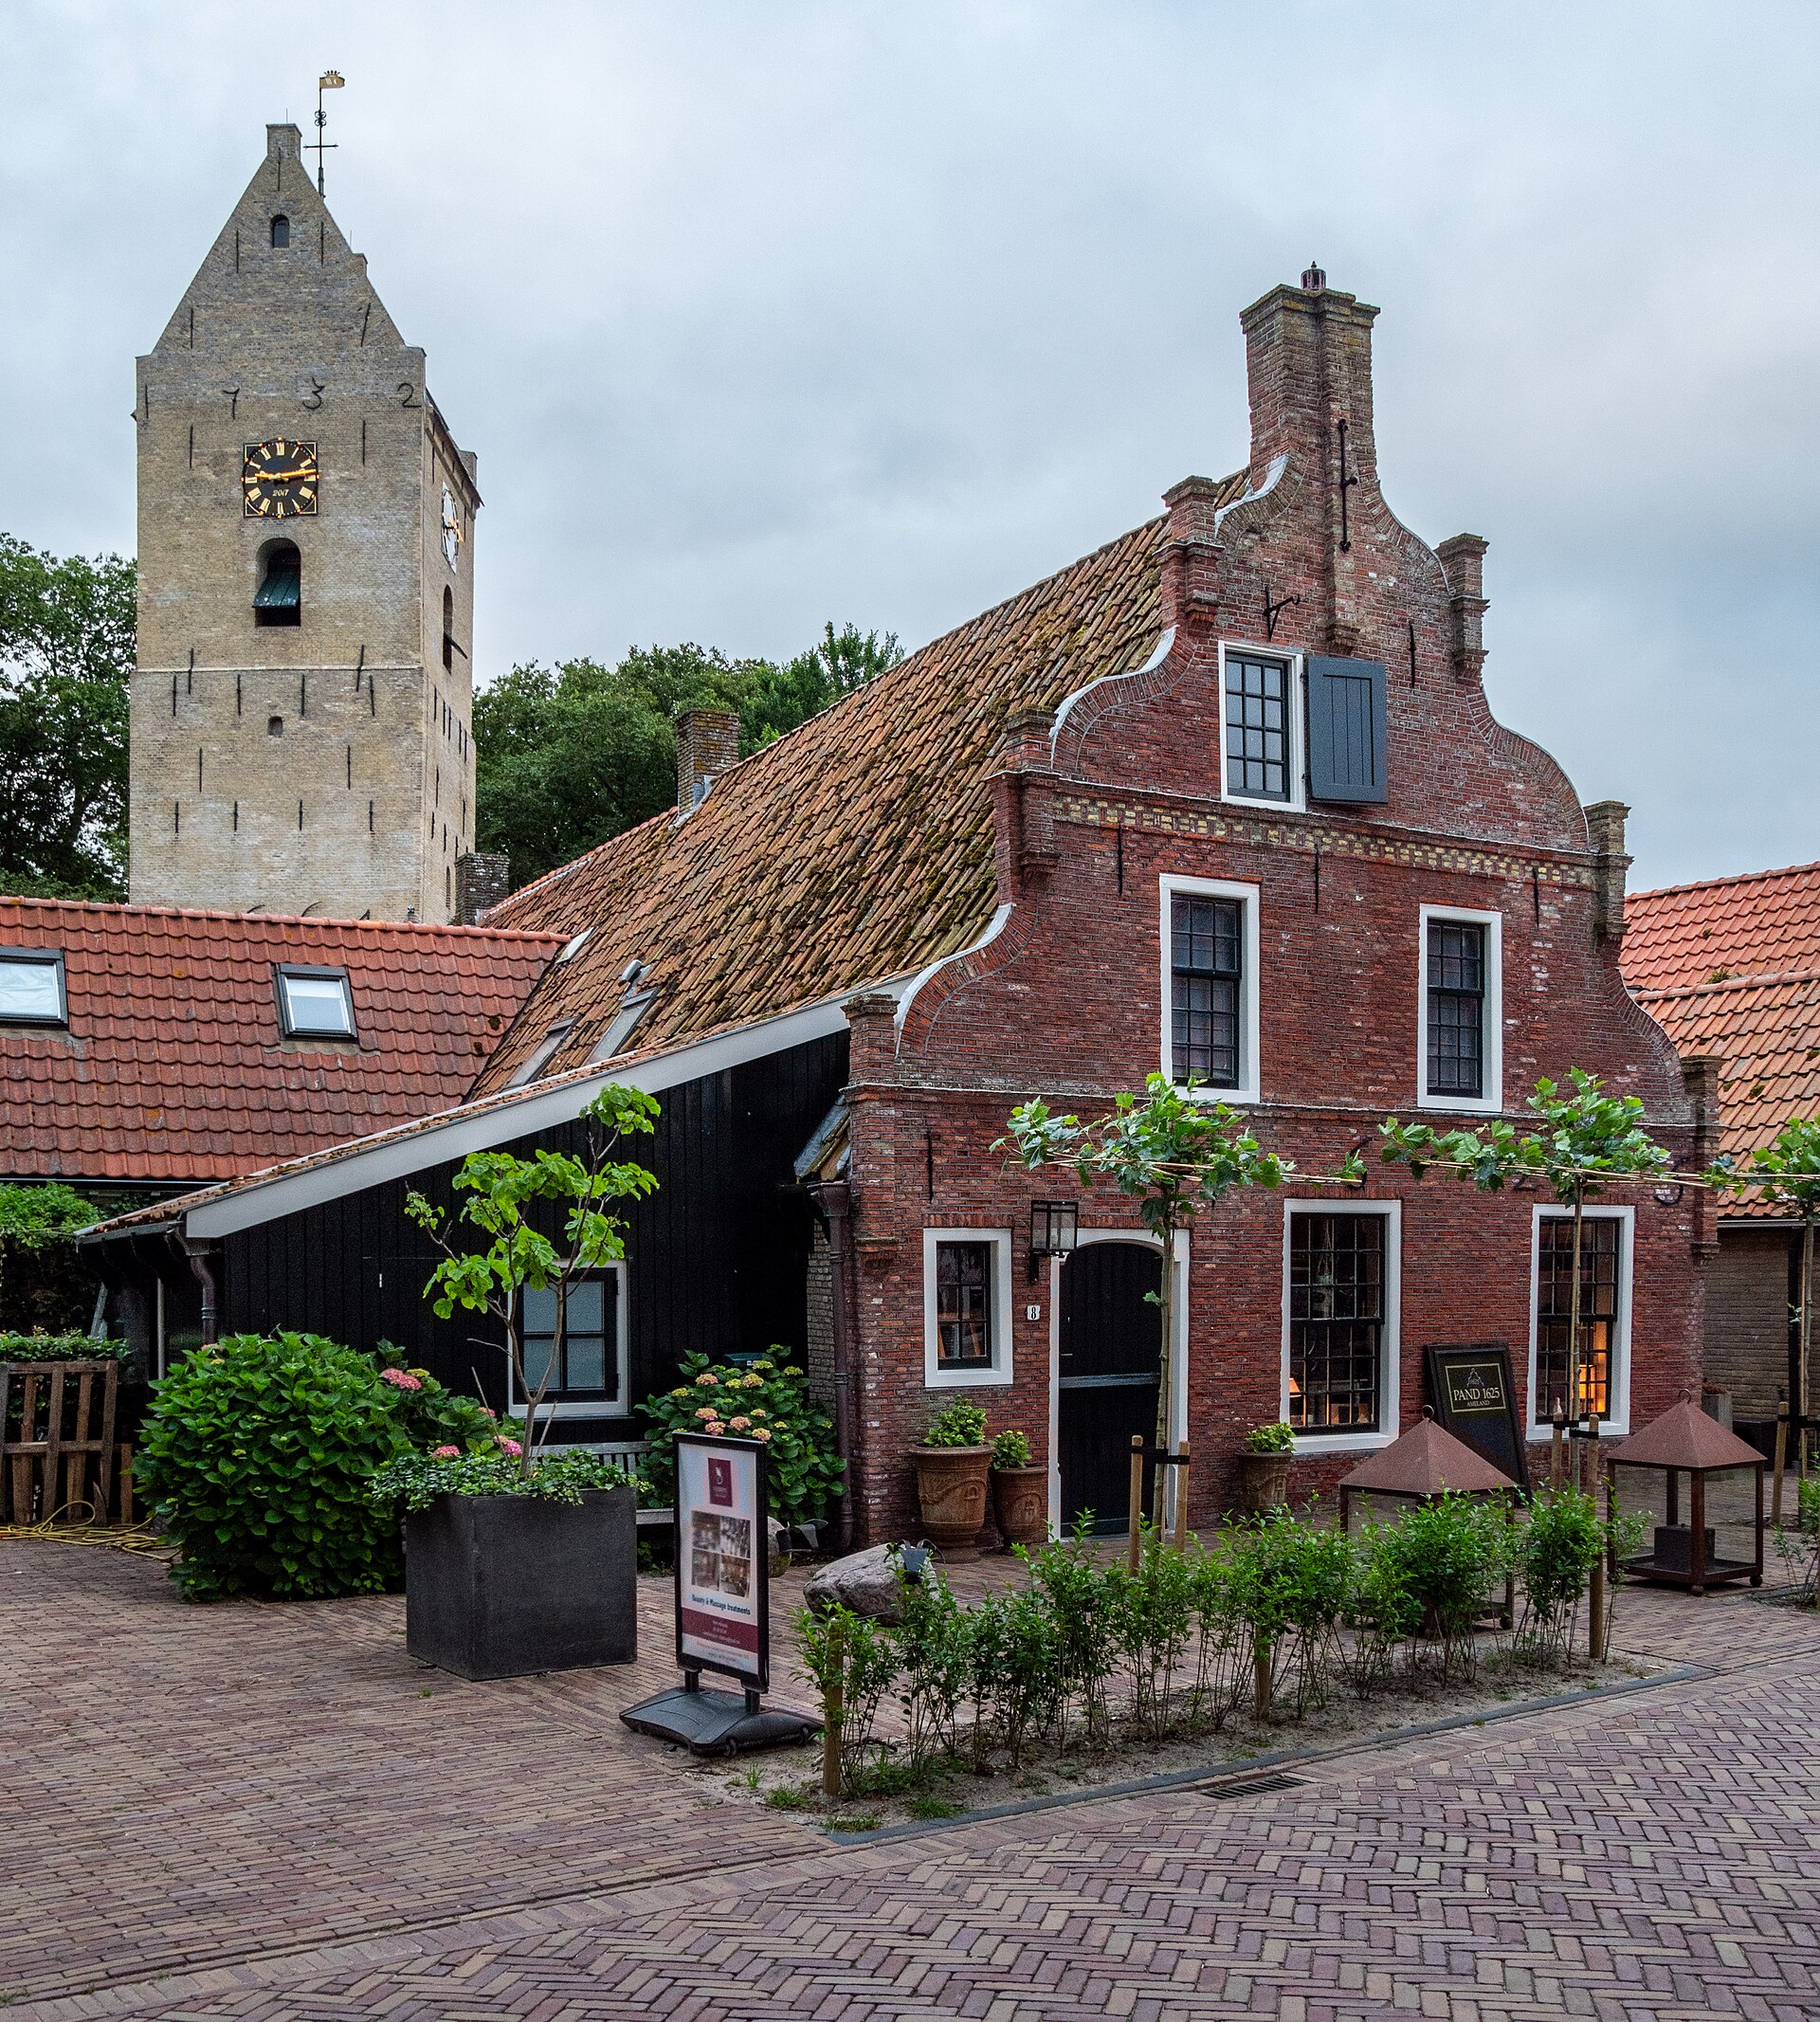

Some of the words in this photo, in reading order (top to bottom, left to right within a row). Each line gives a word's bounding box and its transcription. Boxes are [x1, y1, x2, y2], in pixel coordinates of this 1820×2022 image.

[301, 377, 325, 410] 3
[396, 382, 422, 408] 2
[272, 488, 289, 497] 2017
[1031, 1306, 1036, 1319] 8
[1453, 1388, 1481, 1401] PAND
[1482, 1387, 1501, 1399] 1625
[710, 1599, 726, 1611] Massage
[727, 1603, 751, 1615] treatments
